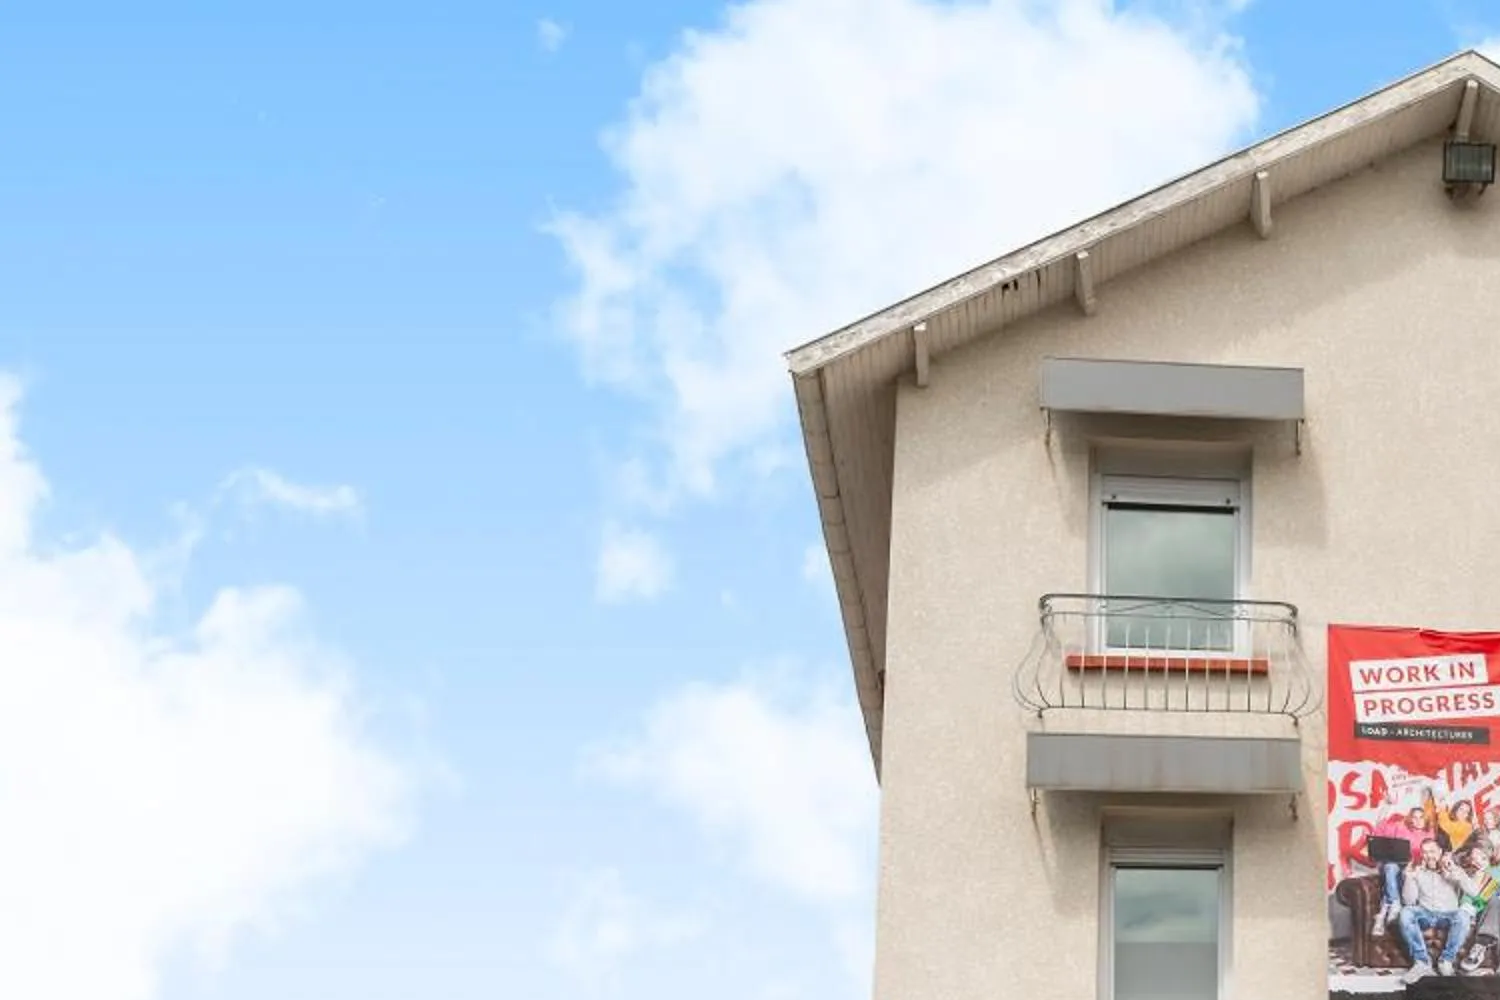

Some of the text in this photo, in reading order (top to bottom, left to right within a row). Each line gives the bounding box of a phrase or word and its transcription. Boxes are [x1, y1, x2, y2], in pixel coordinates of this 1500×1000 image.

[1359, 661, 1476, 685] WORK IN
[1363, 691, 1496, 717] PROGRESS
